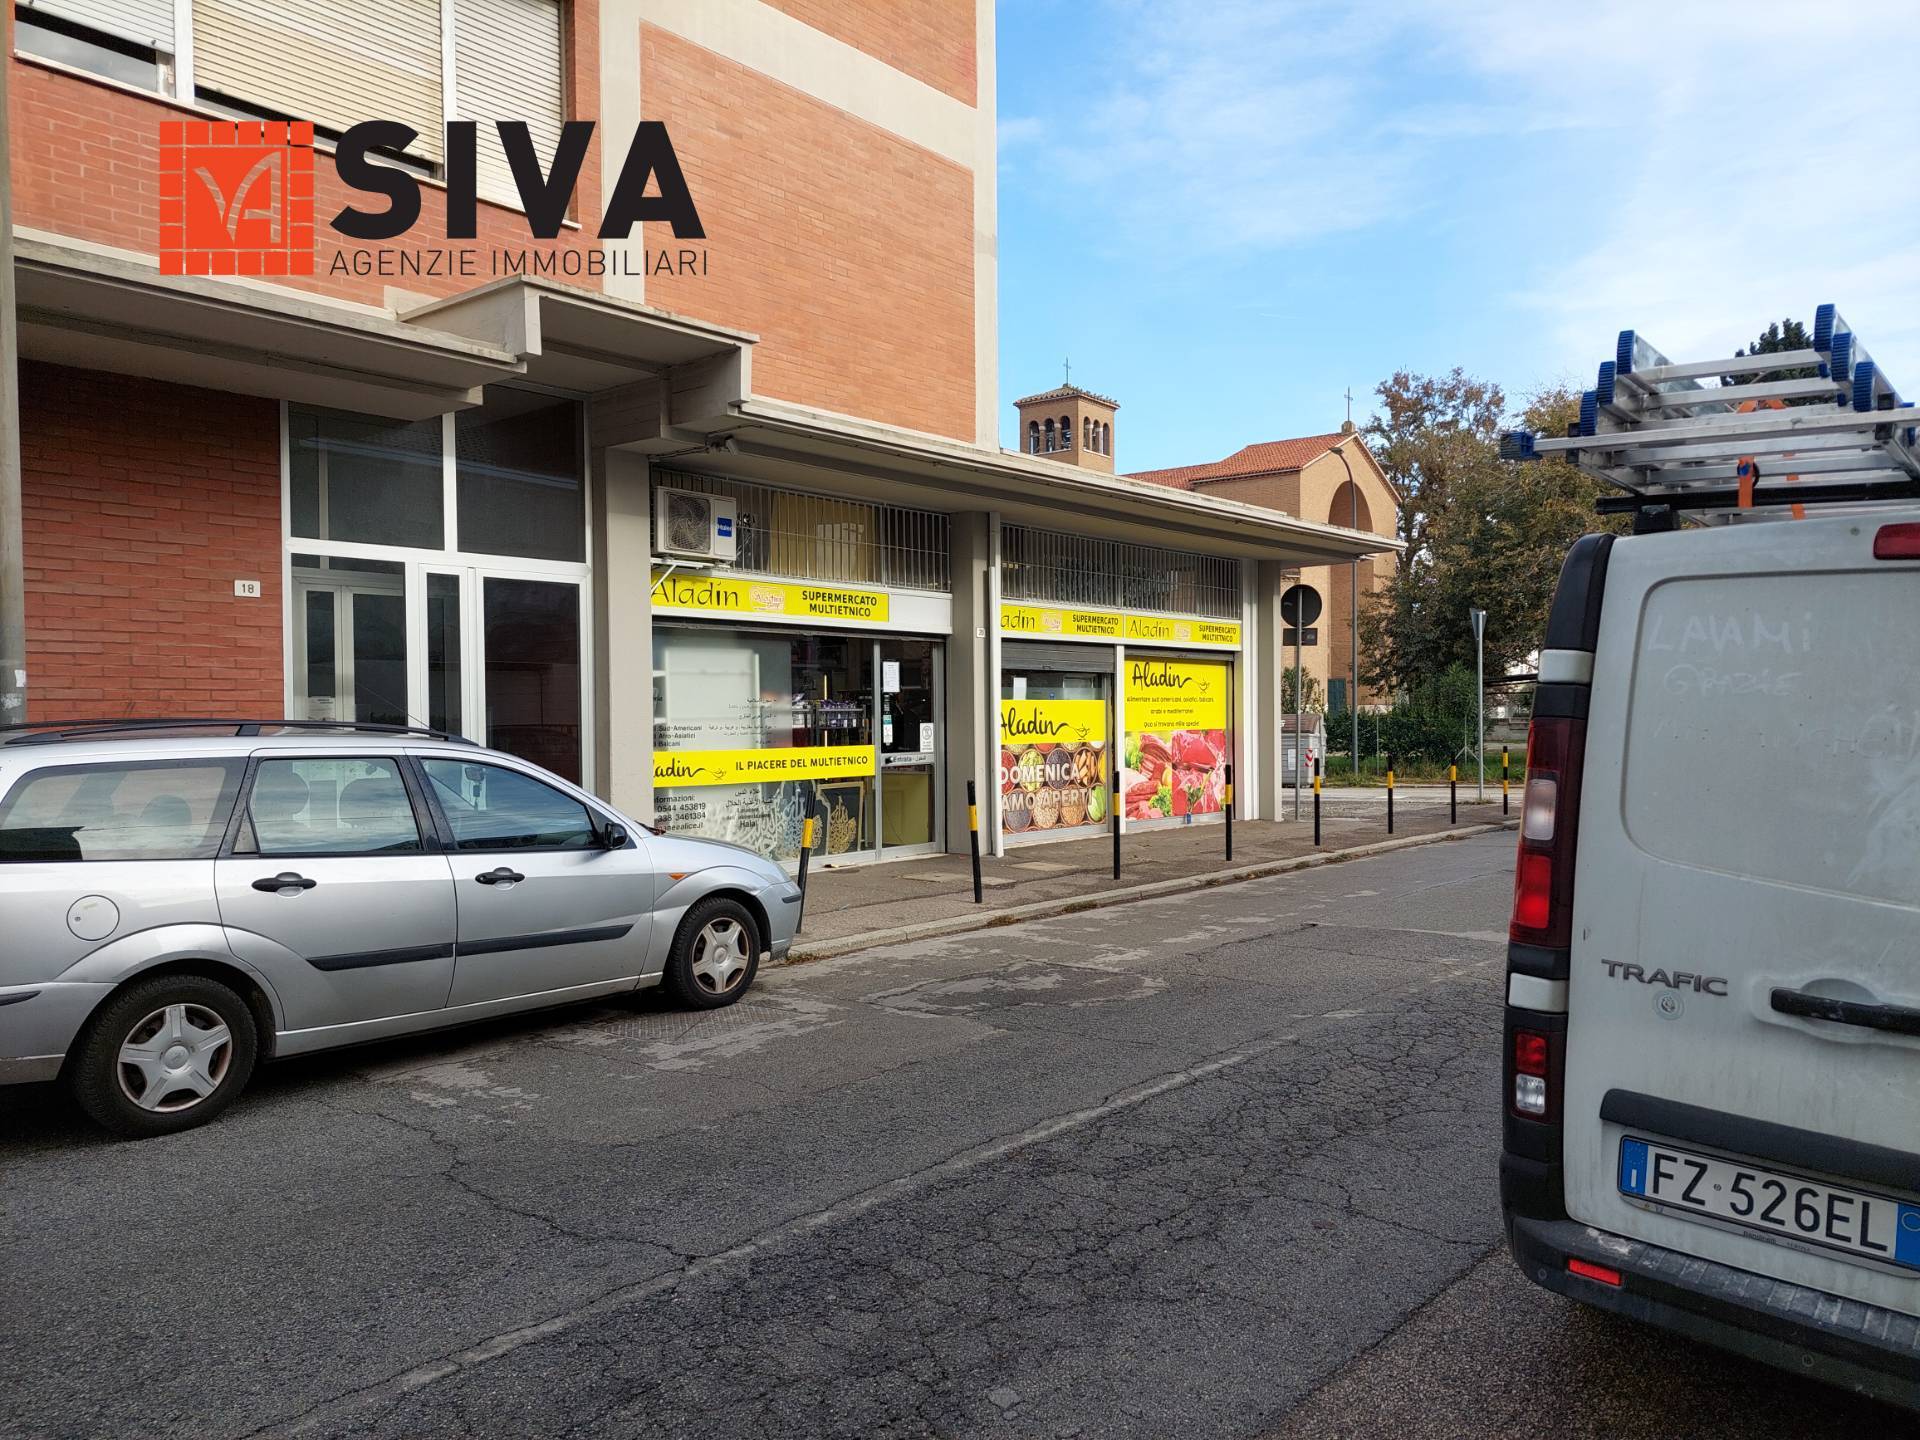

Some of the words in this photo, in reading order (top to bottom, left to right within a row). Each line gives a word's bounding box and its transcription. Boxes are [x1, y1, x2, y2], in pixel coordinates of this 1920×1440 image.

[242, 584, 255, 593] 18
[651, 578, 739, 607] Aladin
[802, 590, 878, 606] SUPERMERCATO
[809, 603, 871, 617] MULTIETNICO
[1000, 610, 1035, 629] adin
[1072, 614, 1119, 625] SUPERMERCATO
[1128, 619, 1170, 637] Aladin
[1076, 625, 1115, 634] MULTIETNICO
[1199, 624, 1237, 634] SUPERMERCATO
[1202, 633, 1233, 642] MULTIETNICO
[1132, 661, 1192, 691] Aladin
[653, 758, 706, 778] adin
[736, 761, 744, 770] IL
[747, 760, 788, 770] PIACERE
[790, 759, 807, 768] DEL
[810, 756, 868, 767] MULTIETNICO
[1001, 762, 1080, 785] DOMENICA
[1001, 792, 1036, 810] AMO
[1601, 958, 1728, 996] TRAFIC
